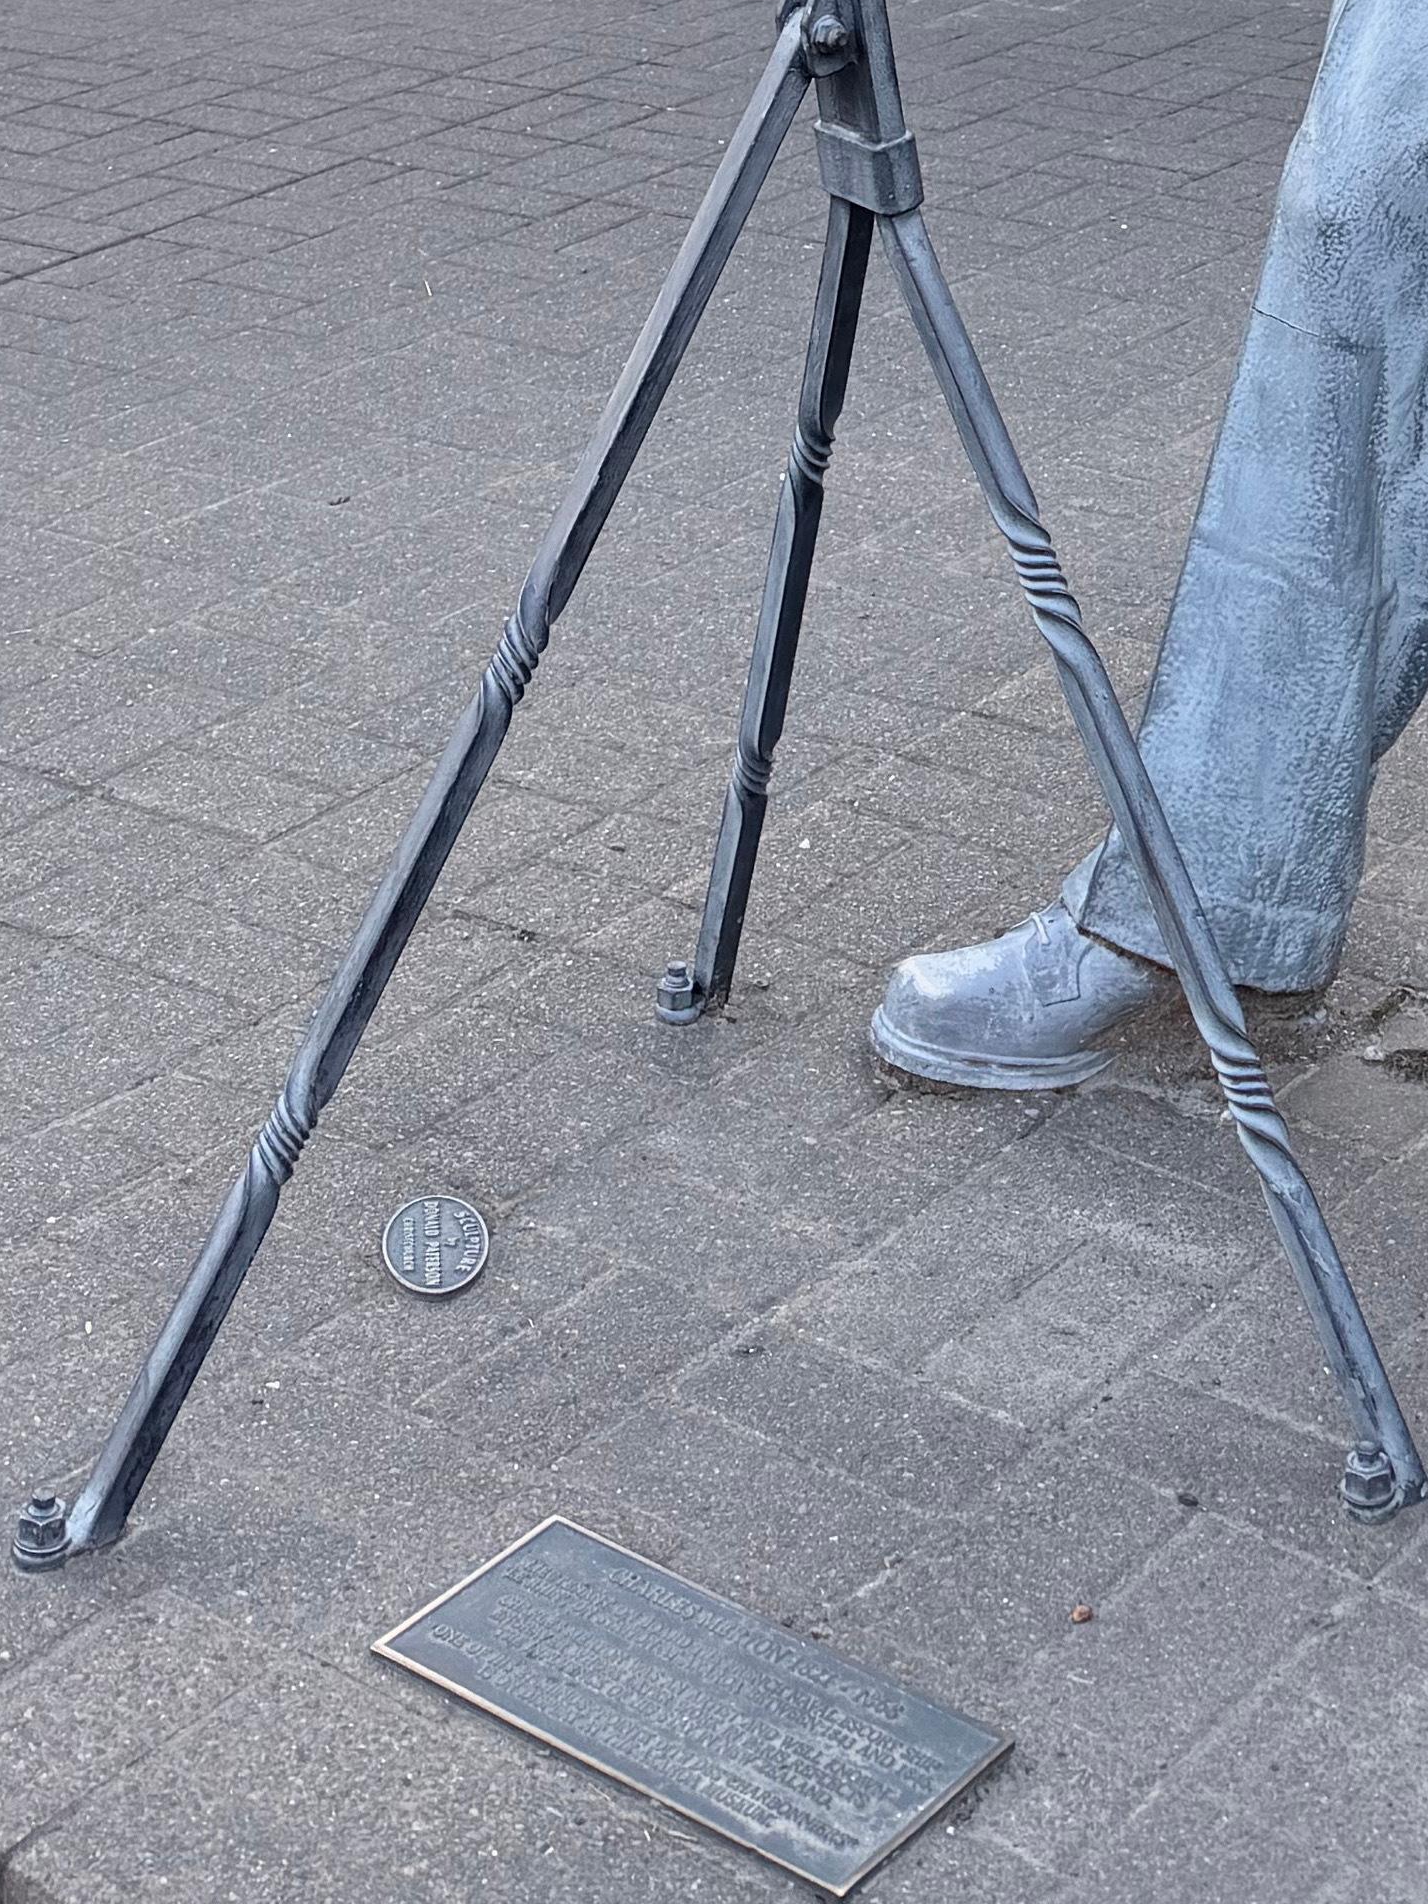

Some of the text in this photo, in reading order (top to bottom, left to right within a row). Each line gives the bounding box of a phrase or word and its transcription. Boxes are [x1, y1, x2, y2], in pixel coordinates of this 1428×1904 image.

[423, 1201, 440, 1286] DONALD PATERSON
[453, 1211, 480, 1272] SCULPTURE
[602, 1565, 705, 1621] CHARLES
[737, 1715, 782, 1743] AND
[774, 1734, 828, 1766] WELL
[781, 1688, 845, 1725] NAVAL
[834, 1715, 906, 1755] ESCORT
[896, 1746, 944, 1775] SHIP
[851, 1742, 899, 1771] AND
[783, 1757, 876, 1810] REFLECTS
